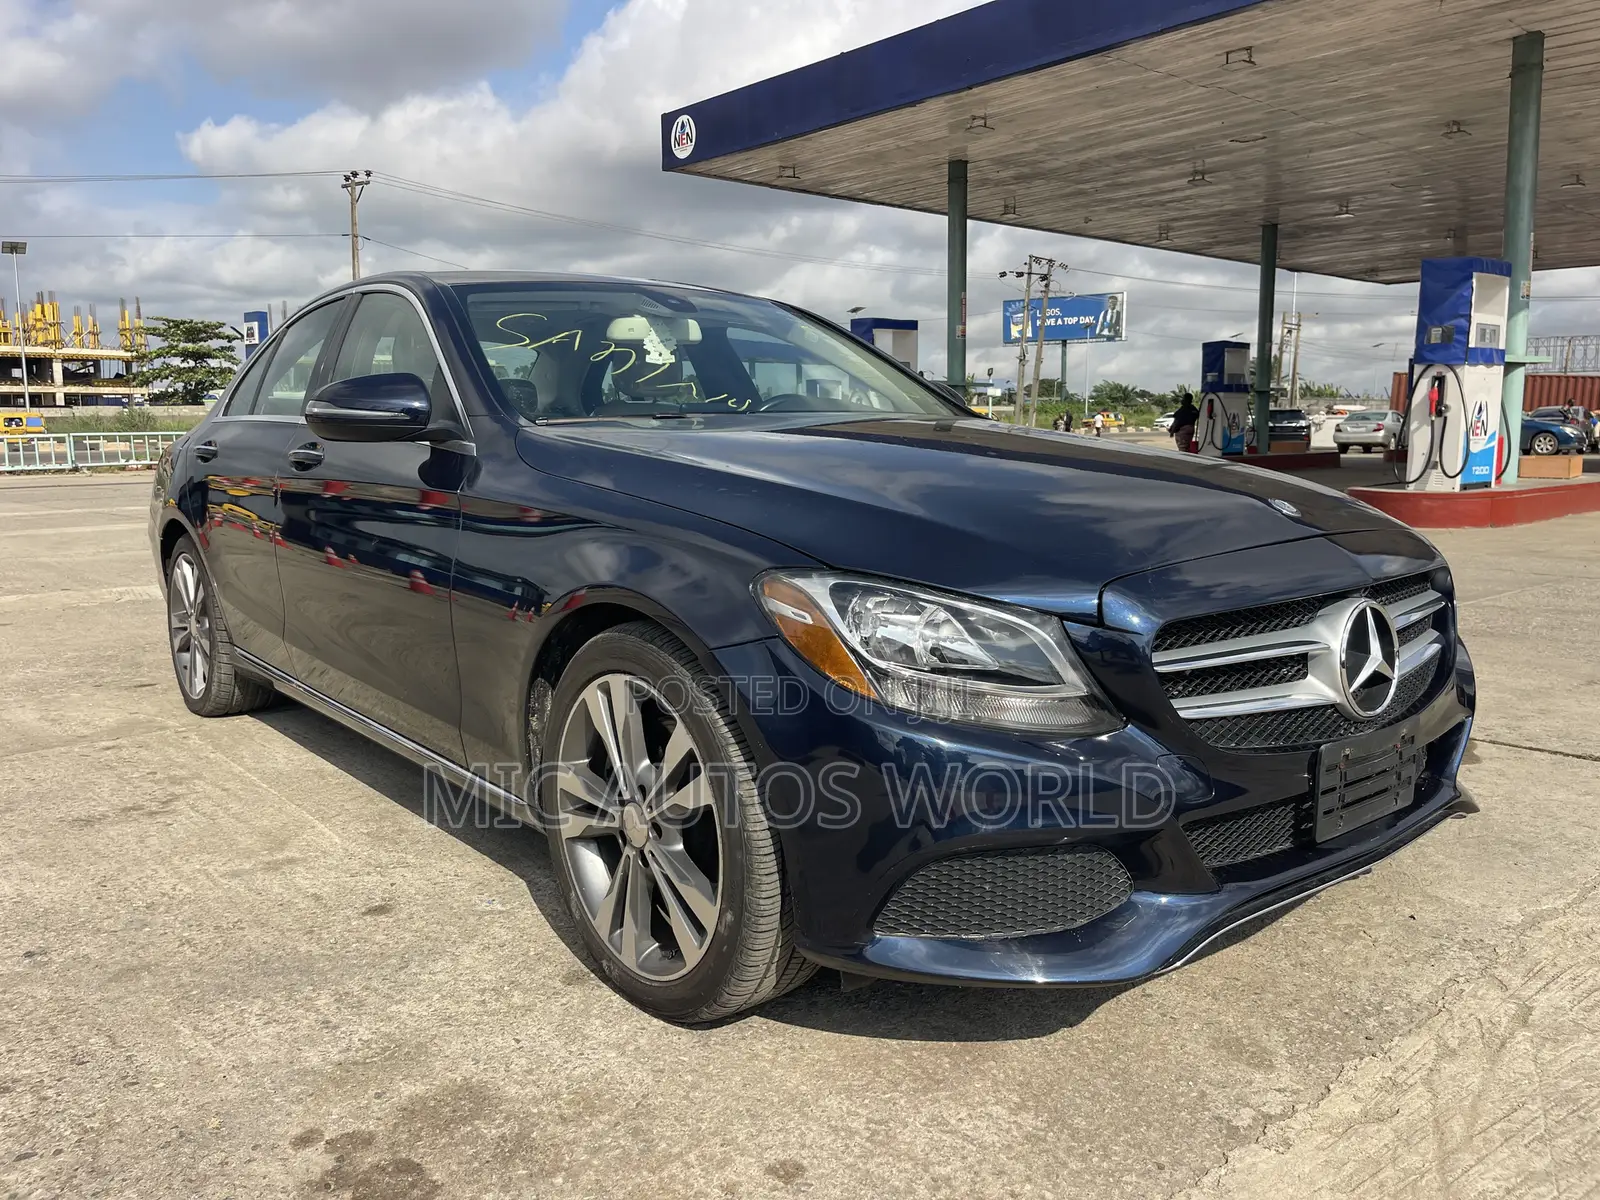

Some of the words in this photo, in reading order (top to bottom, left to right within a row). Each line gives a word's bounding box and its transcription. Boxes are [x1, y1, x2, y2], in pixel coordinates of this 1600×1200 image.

[674, 118, 693, 148] NEN
[1036, 308, 1063, 317] LGOS.
[1056, 318, 1063, 326] A
[1063, 316, 1079, 325] TOP
[1079, 315, 1096, 324] DAY.
